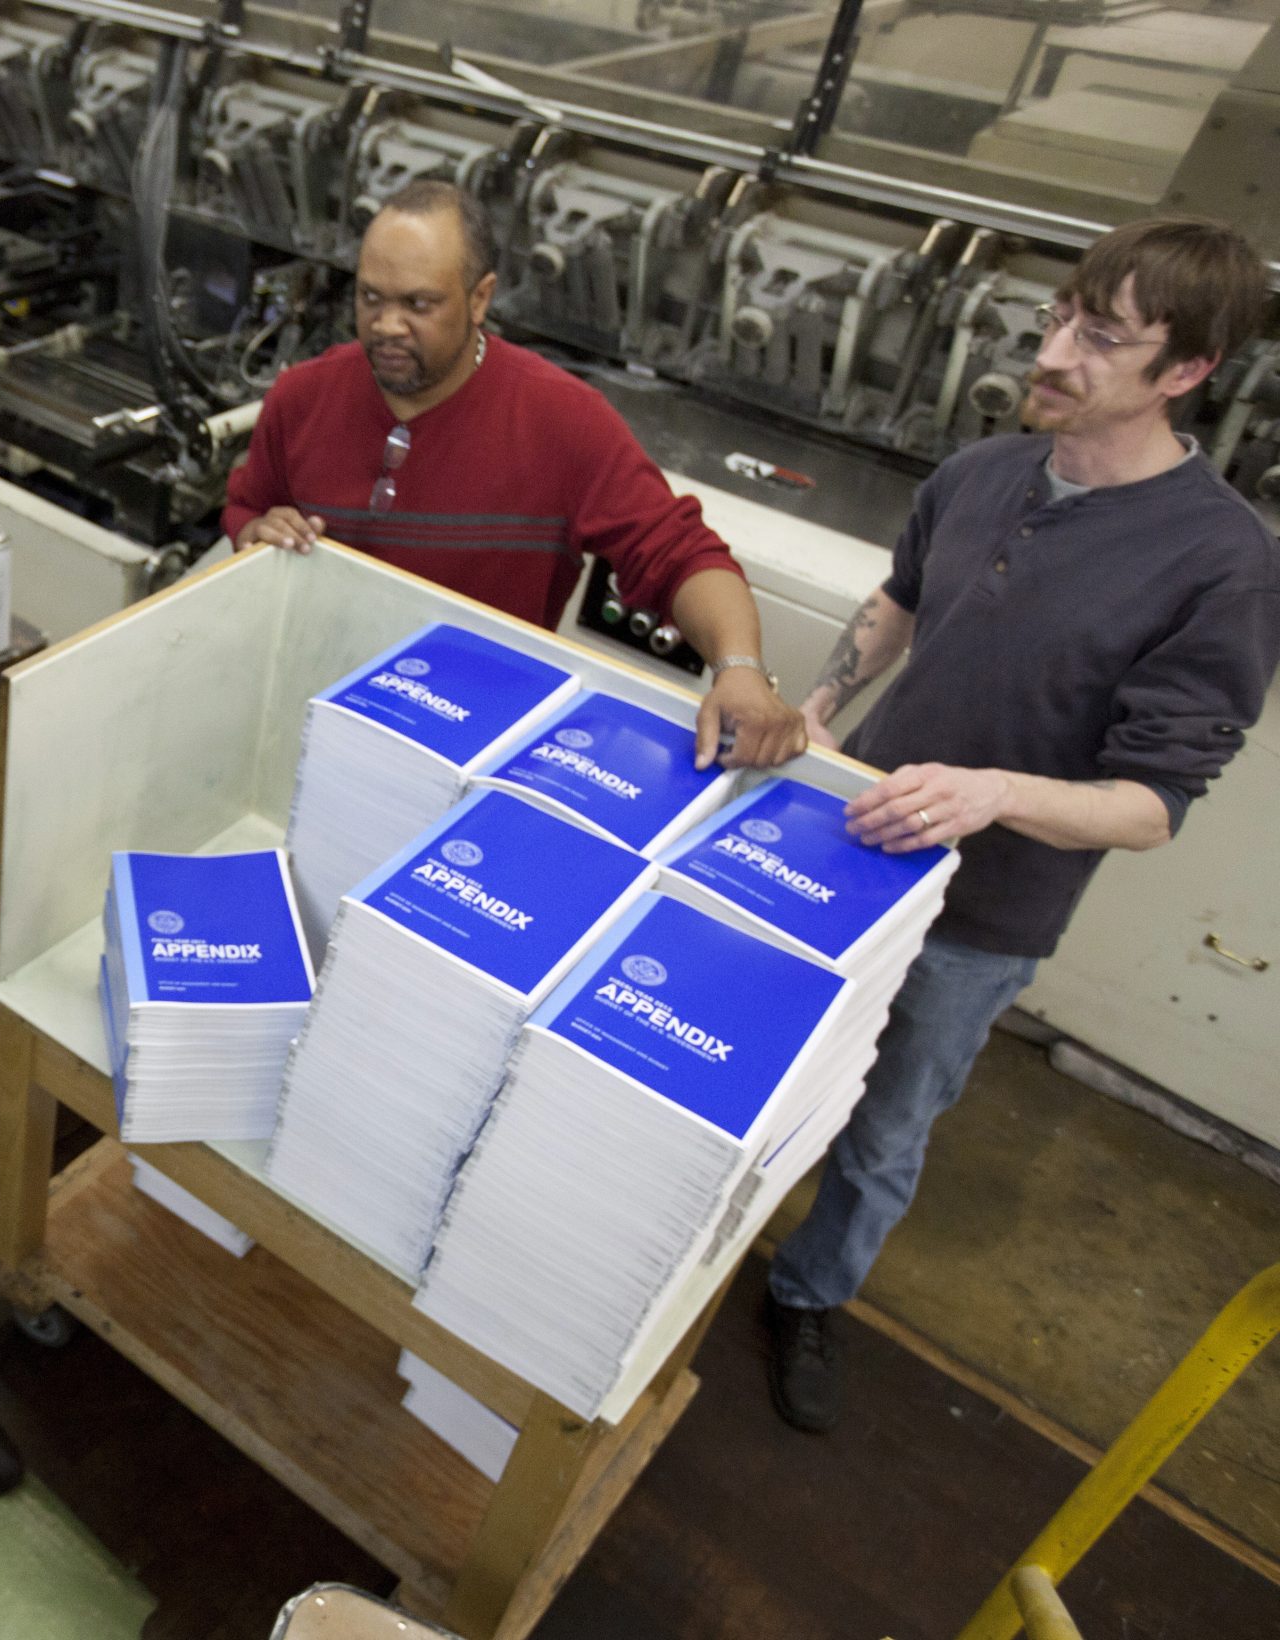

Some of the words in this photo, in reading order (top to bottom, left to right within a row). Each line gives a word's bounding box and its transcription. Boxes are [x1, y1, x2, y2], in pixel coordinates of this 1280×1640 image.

[369, 674, 471, 722] APPENDIX
[531, 744, 643, 800] APPENDIX
[413, 863, 535, 931] APPENDIX
[713, 837, 837, 904] APPENDIX
[151, 943, 263, 960] APPENDIX
[595, 982, 734, 1062] APPENDIX
